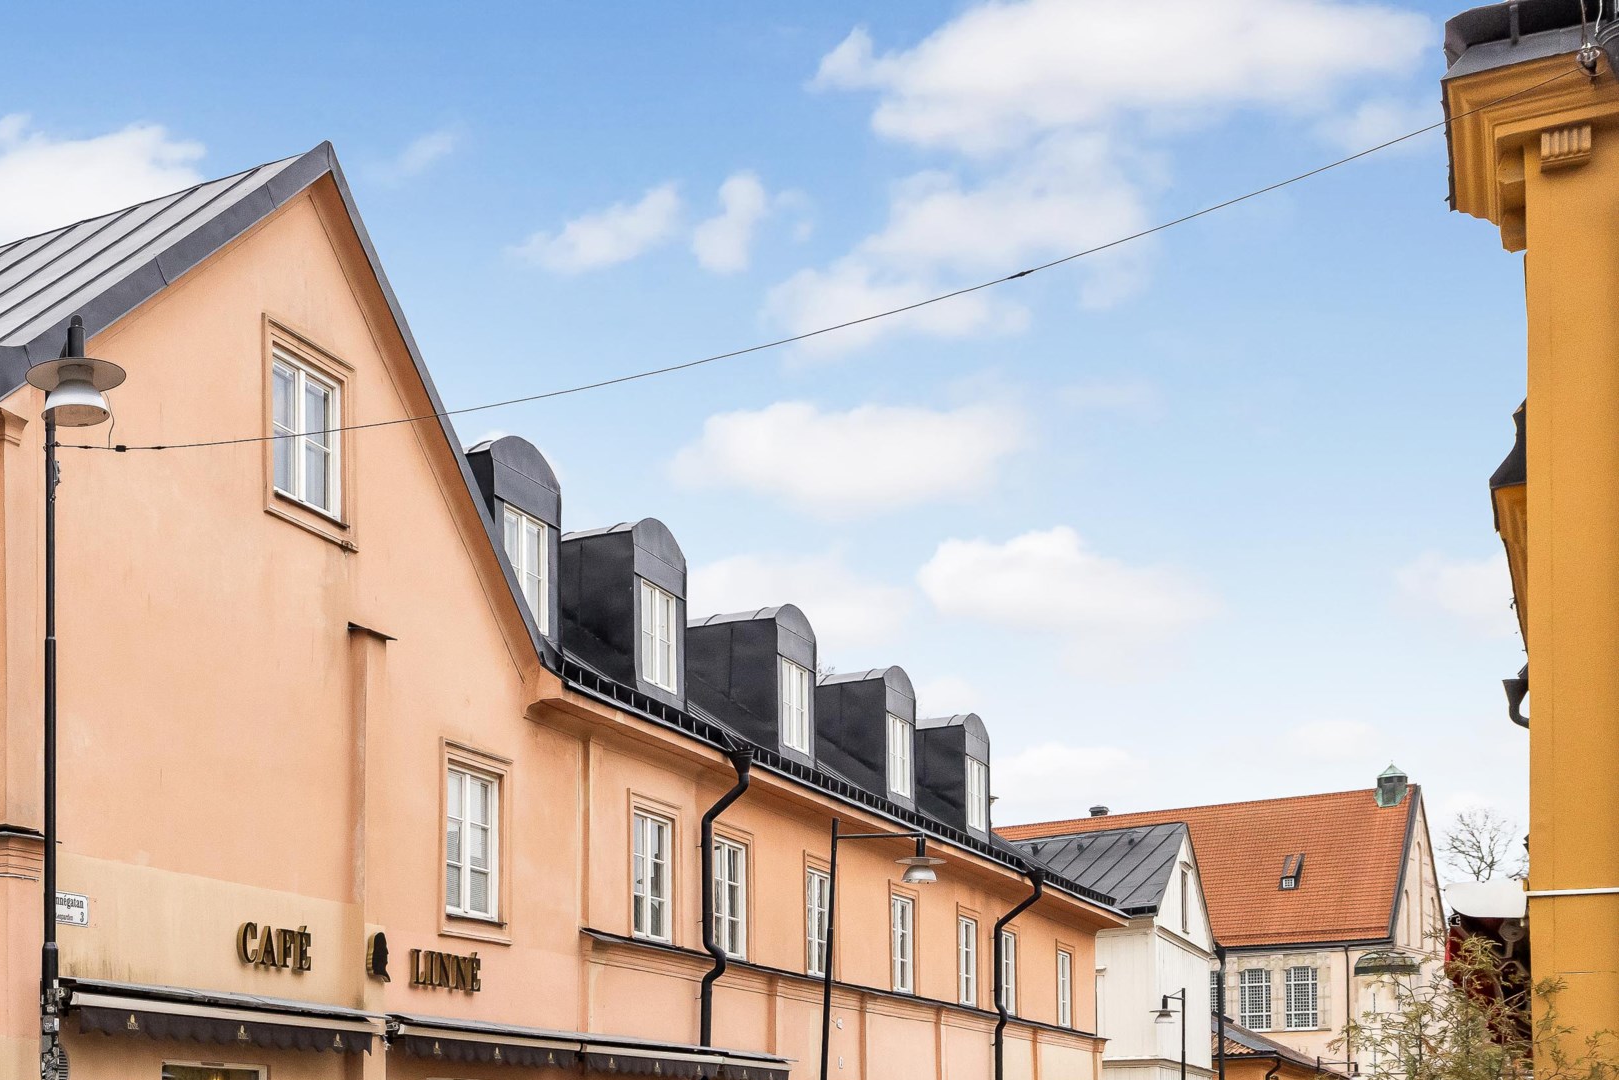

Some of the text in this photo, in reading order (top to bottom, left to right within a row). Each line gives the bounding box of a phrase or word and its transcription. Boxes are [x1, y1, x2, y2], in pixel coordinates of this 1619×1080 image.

[55, 894, 84, 909] nnégatan
[79, 911, 85, 922] 3
[236, 921, 481, 992] CAFÉ LINNÉ
